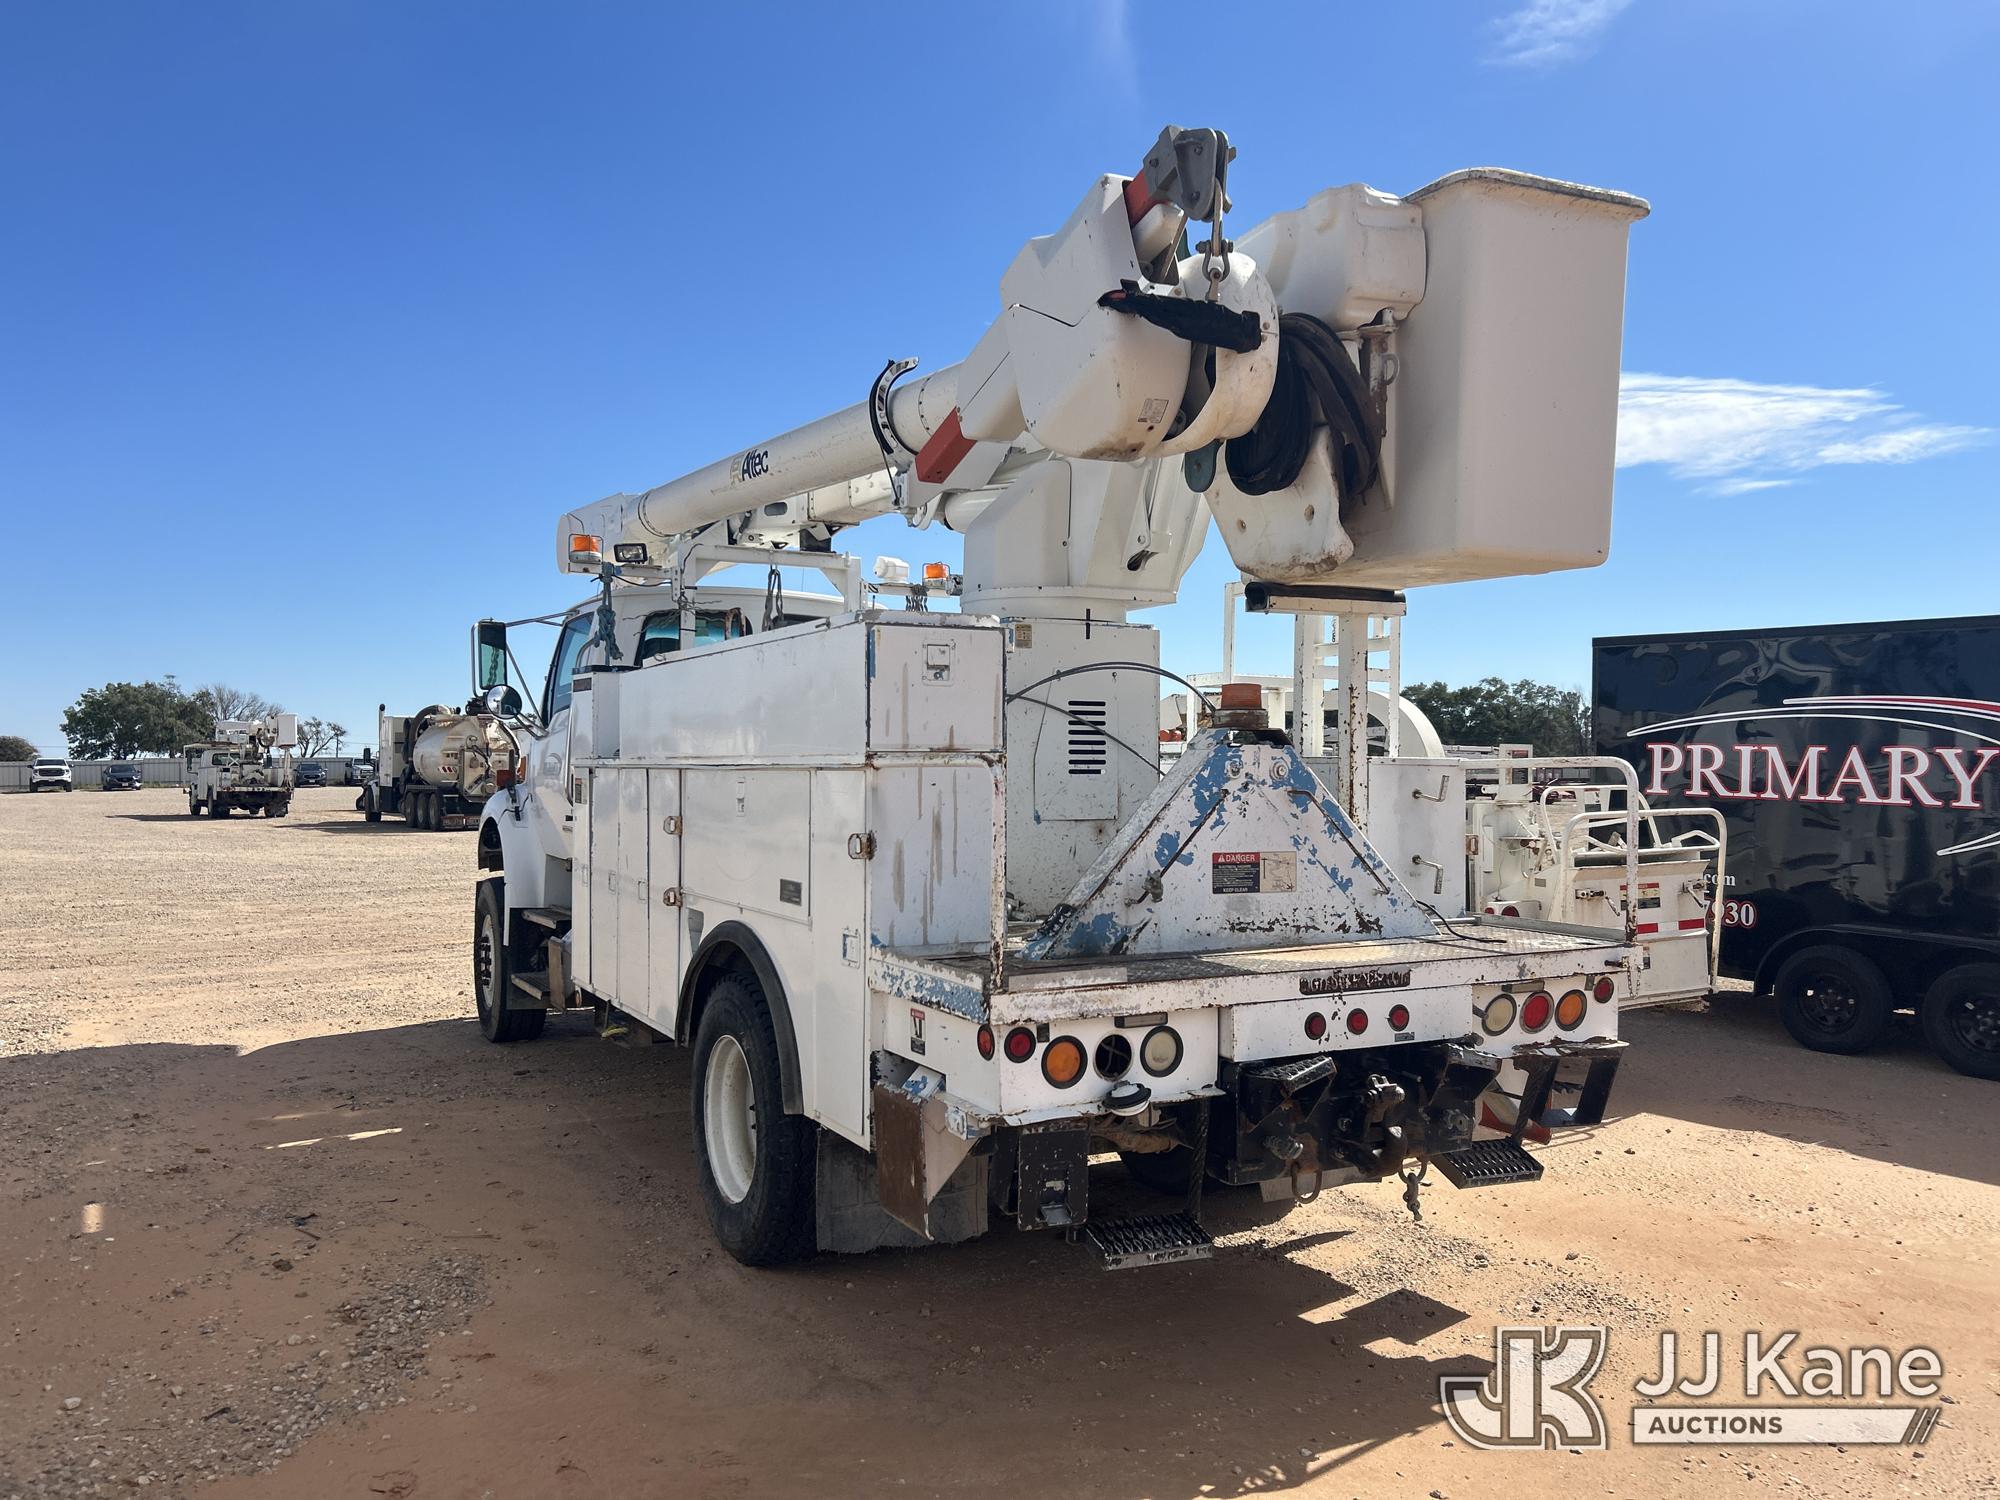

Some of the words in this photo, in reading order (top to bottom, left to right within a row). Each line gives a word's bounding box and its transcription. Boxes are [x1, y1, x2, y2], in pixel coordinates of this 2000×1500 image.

[742, 449, 769, 481] Altec
[1646, 742, 2000, 809] PRIMARY
[1225, 854, 1255, 862] DANGER
